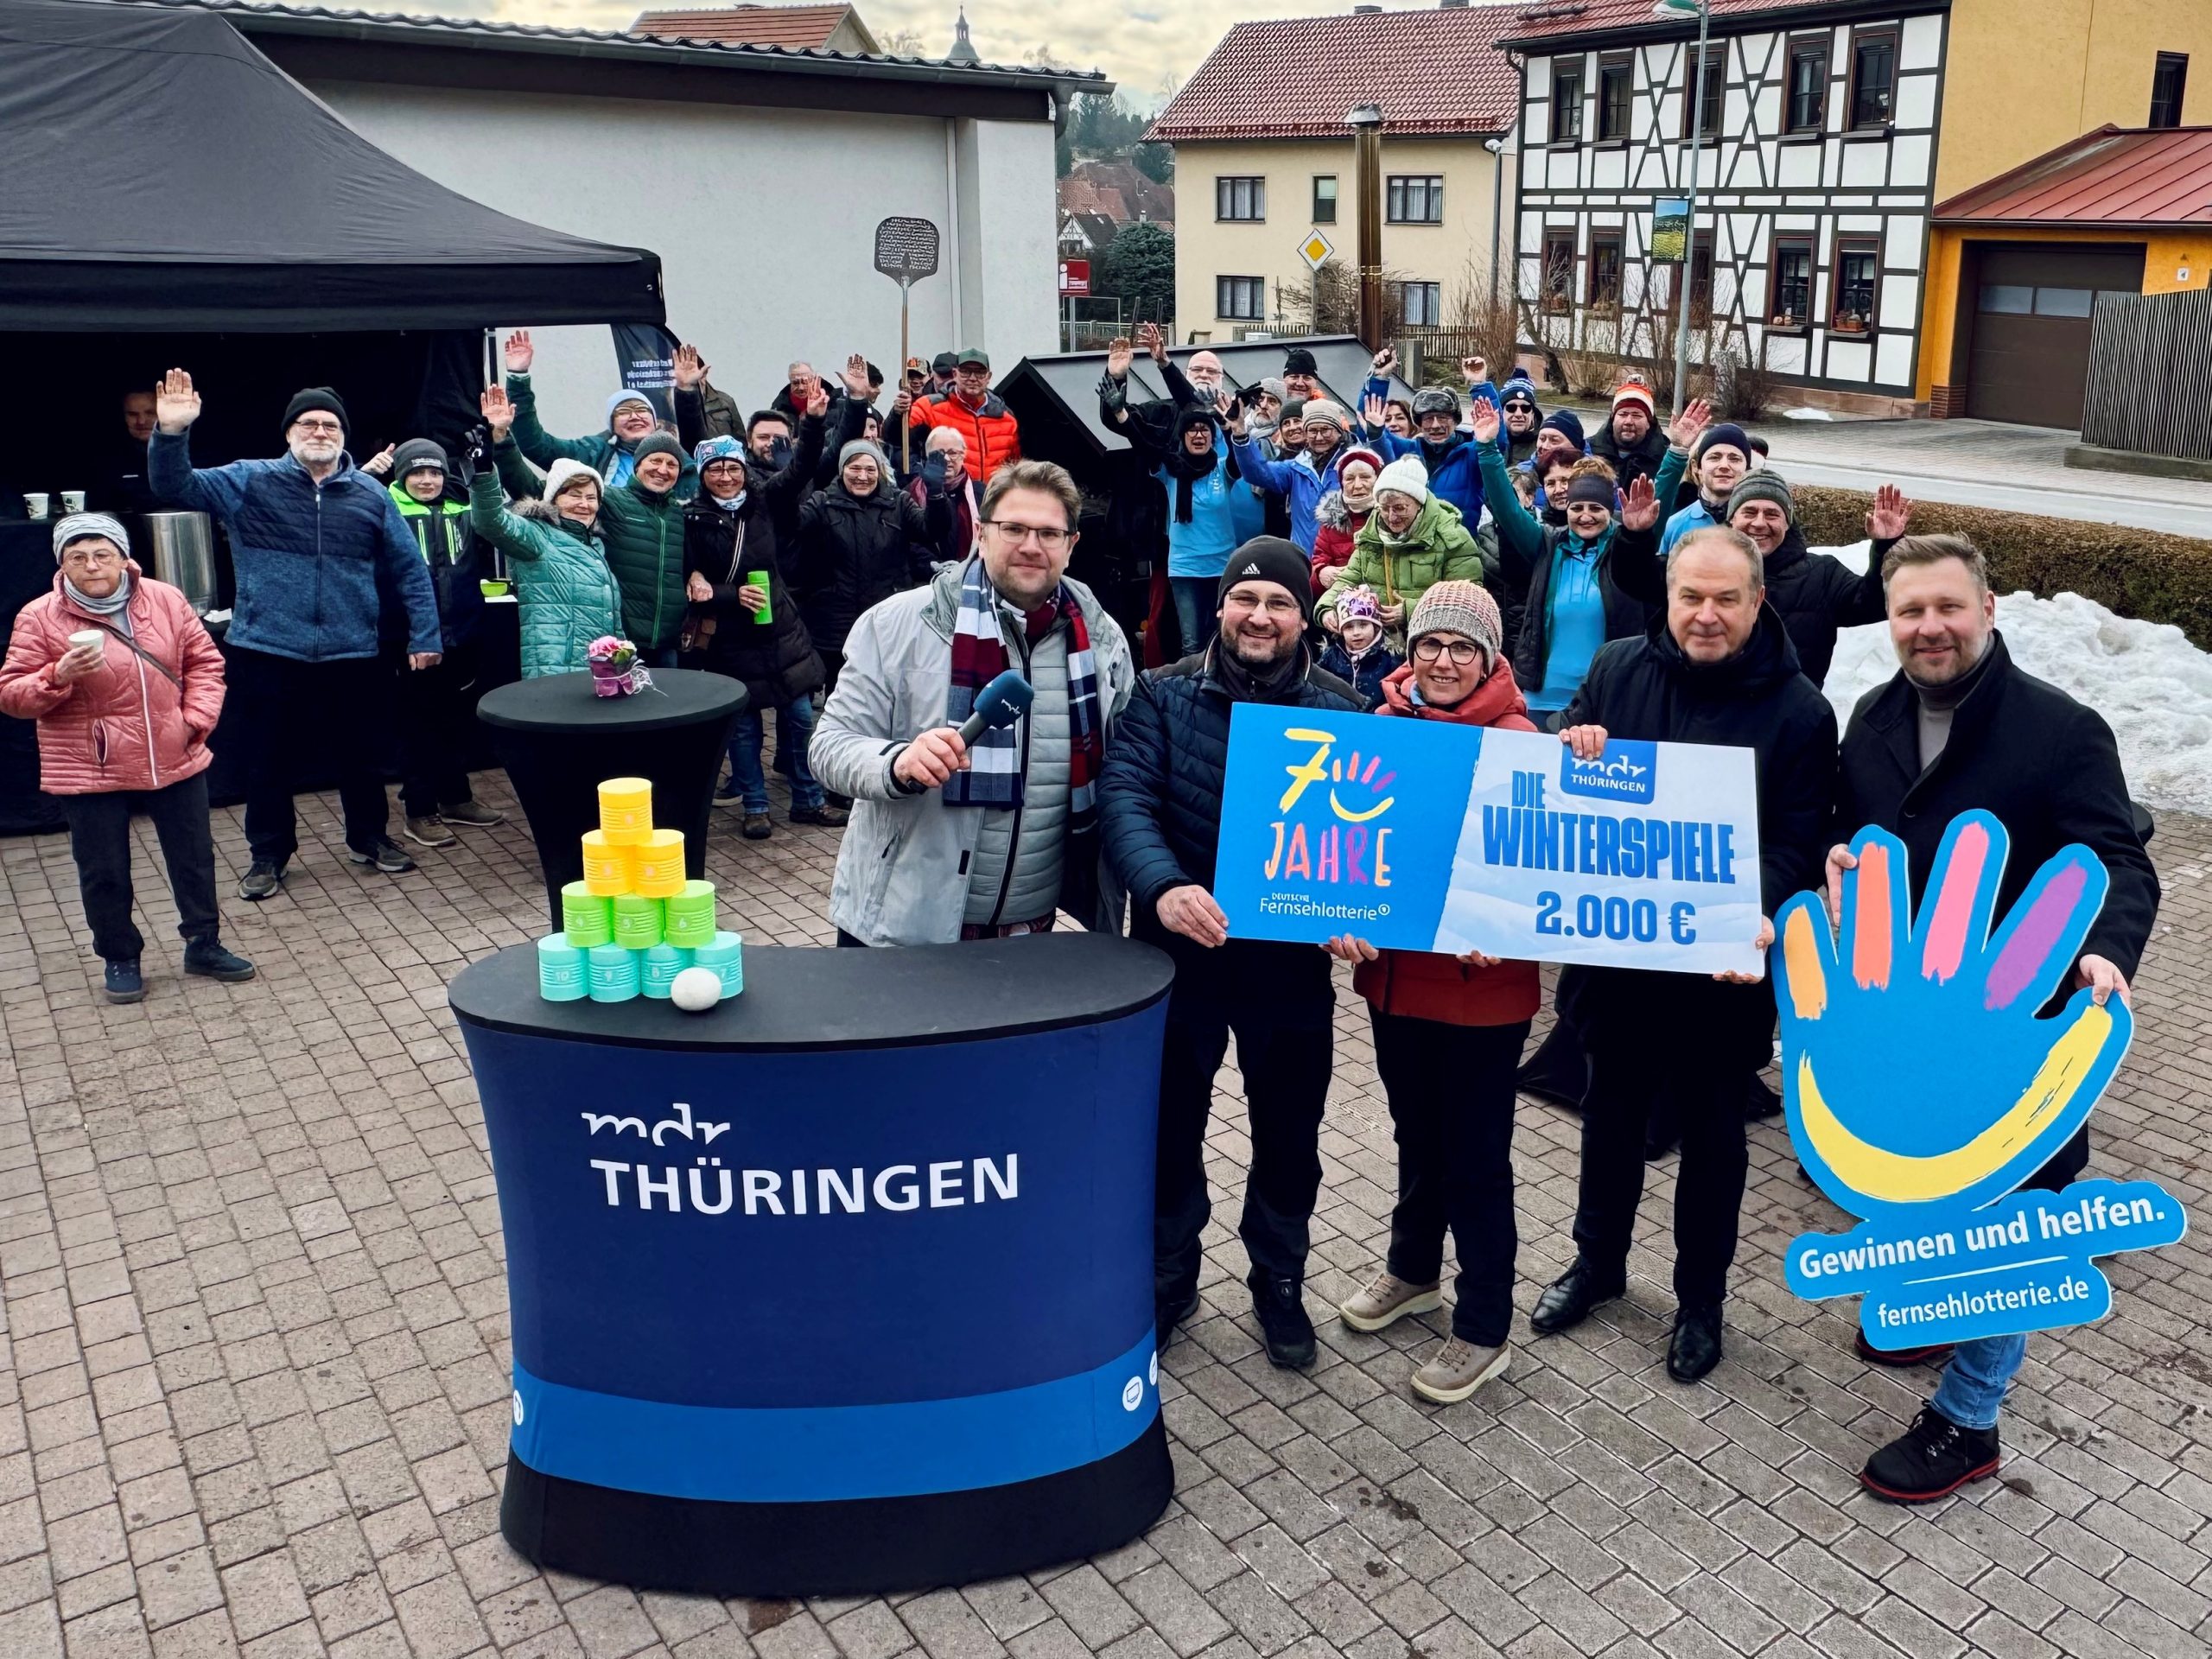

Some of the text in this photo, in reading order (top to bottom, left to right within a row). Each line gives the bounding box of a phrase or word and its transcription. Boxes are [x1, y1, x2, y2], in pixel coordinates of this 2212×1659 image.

[1511, 770, 1546, 810] DIE
[1571, 754, 1647, 778] mdr
[1571, 773, 1646, 793] THÜRINGEN
[1264, 821, 1393, 887] JAHRE
[1482, 804, 1736, 884] WINTERSPIELE
[1259, 897, 1377, 921] Fernsehlotterie
[1535, 890, 1696, 944] 2.000 €
[581, 1103, 731, 1146] mdr
[590, 1153, 1019, 1215] THÜRINGEN
[1799, 1194, 2166, 1279] Gewinnen und helfen.
[1877, 1275, 2090, 1328] fernsehlotterie.de
